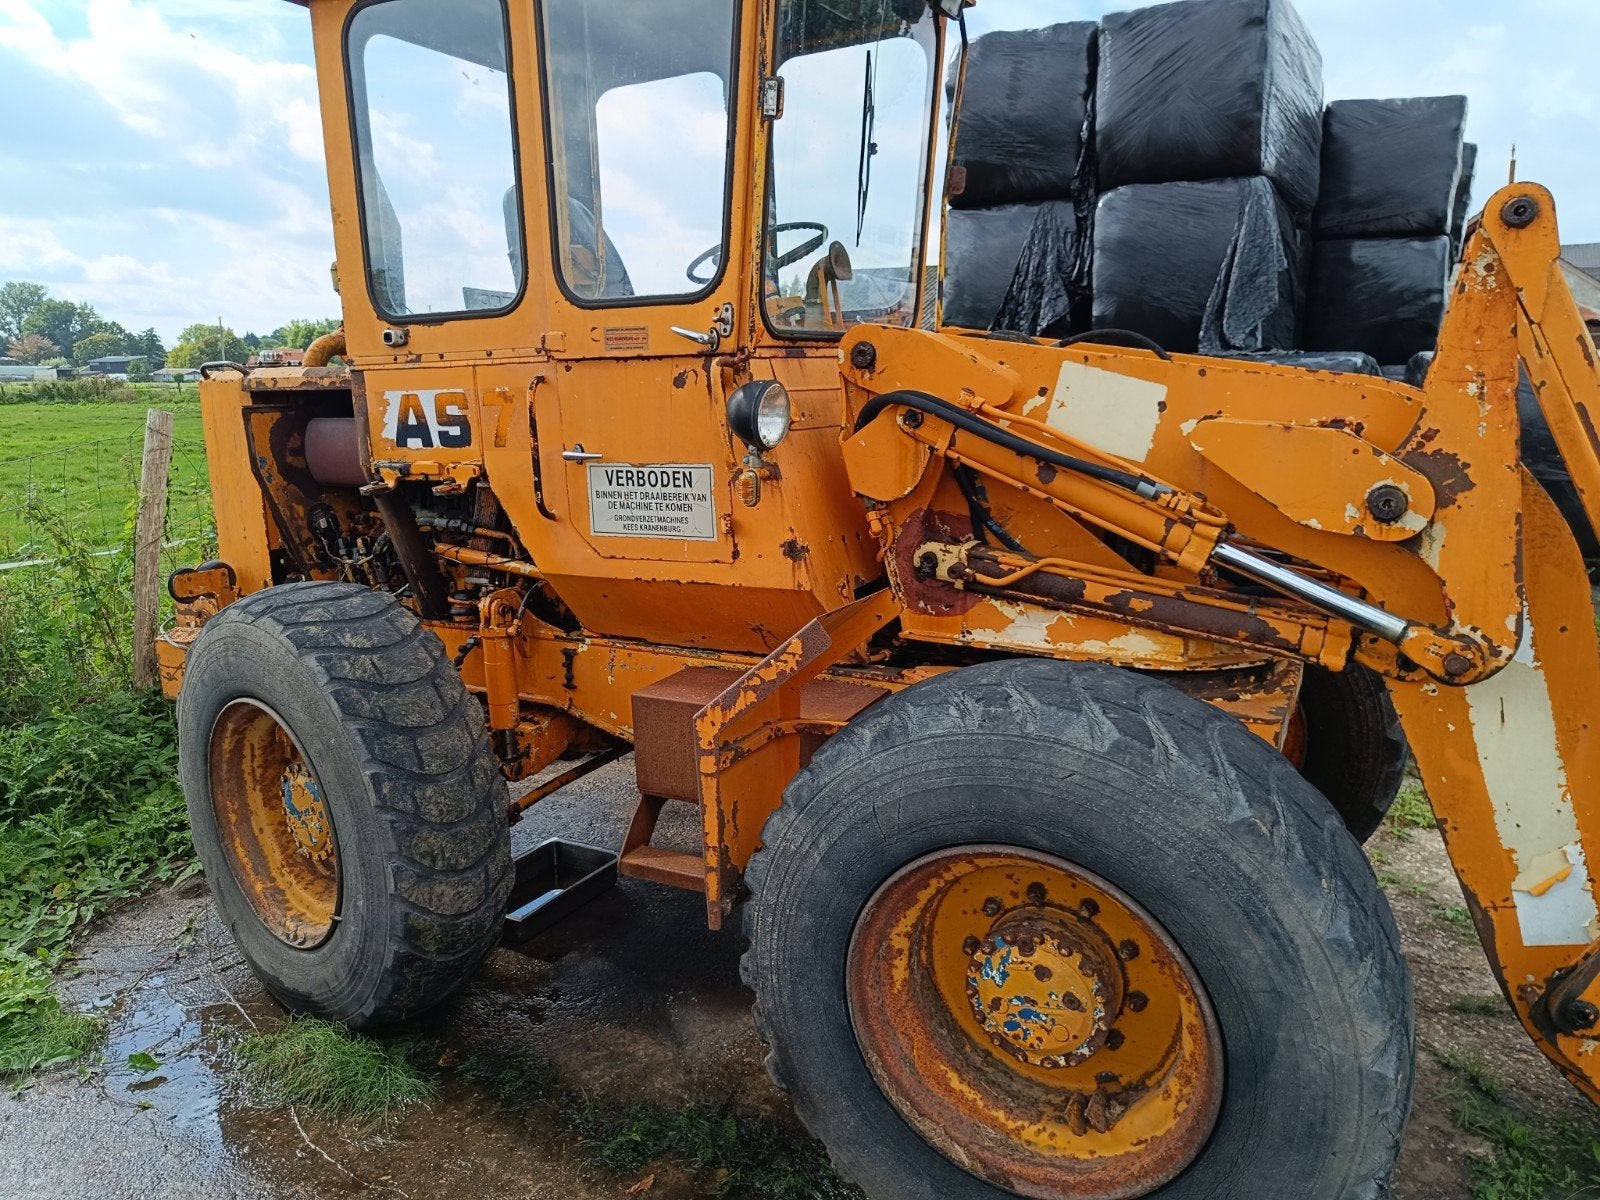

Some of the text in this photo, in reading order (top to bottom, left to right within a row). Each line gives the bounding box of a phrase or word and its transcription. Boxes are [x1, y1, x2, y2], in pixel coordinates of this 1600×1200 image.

[395, 391, 472, 448] AS
[605, 469, 693, 488] VERBODEN
[595, 490, 707, 502] BINNEN HET DRAAIBEREIK VAN
[608, 501, 693, 512] DE MACHINE TE KOMEN
[614, 514, 689, 524] GRONDVERZETMACHINES
[623, 523, 639, 531] KEES
